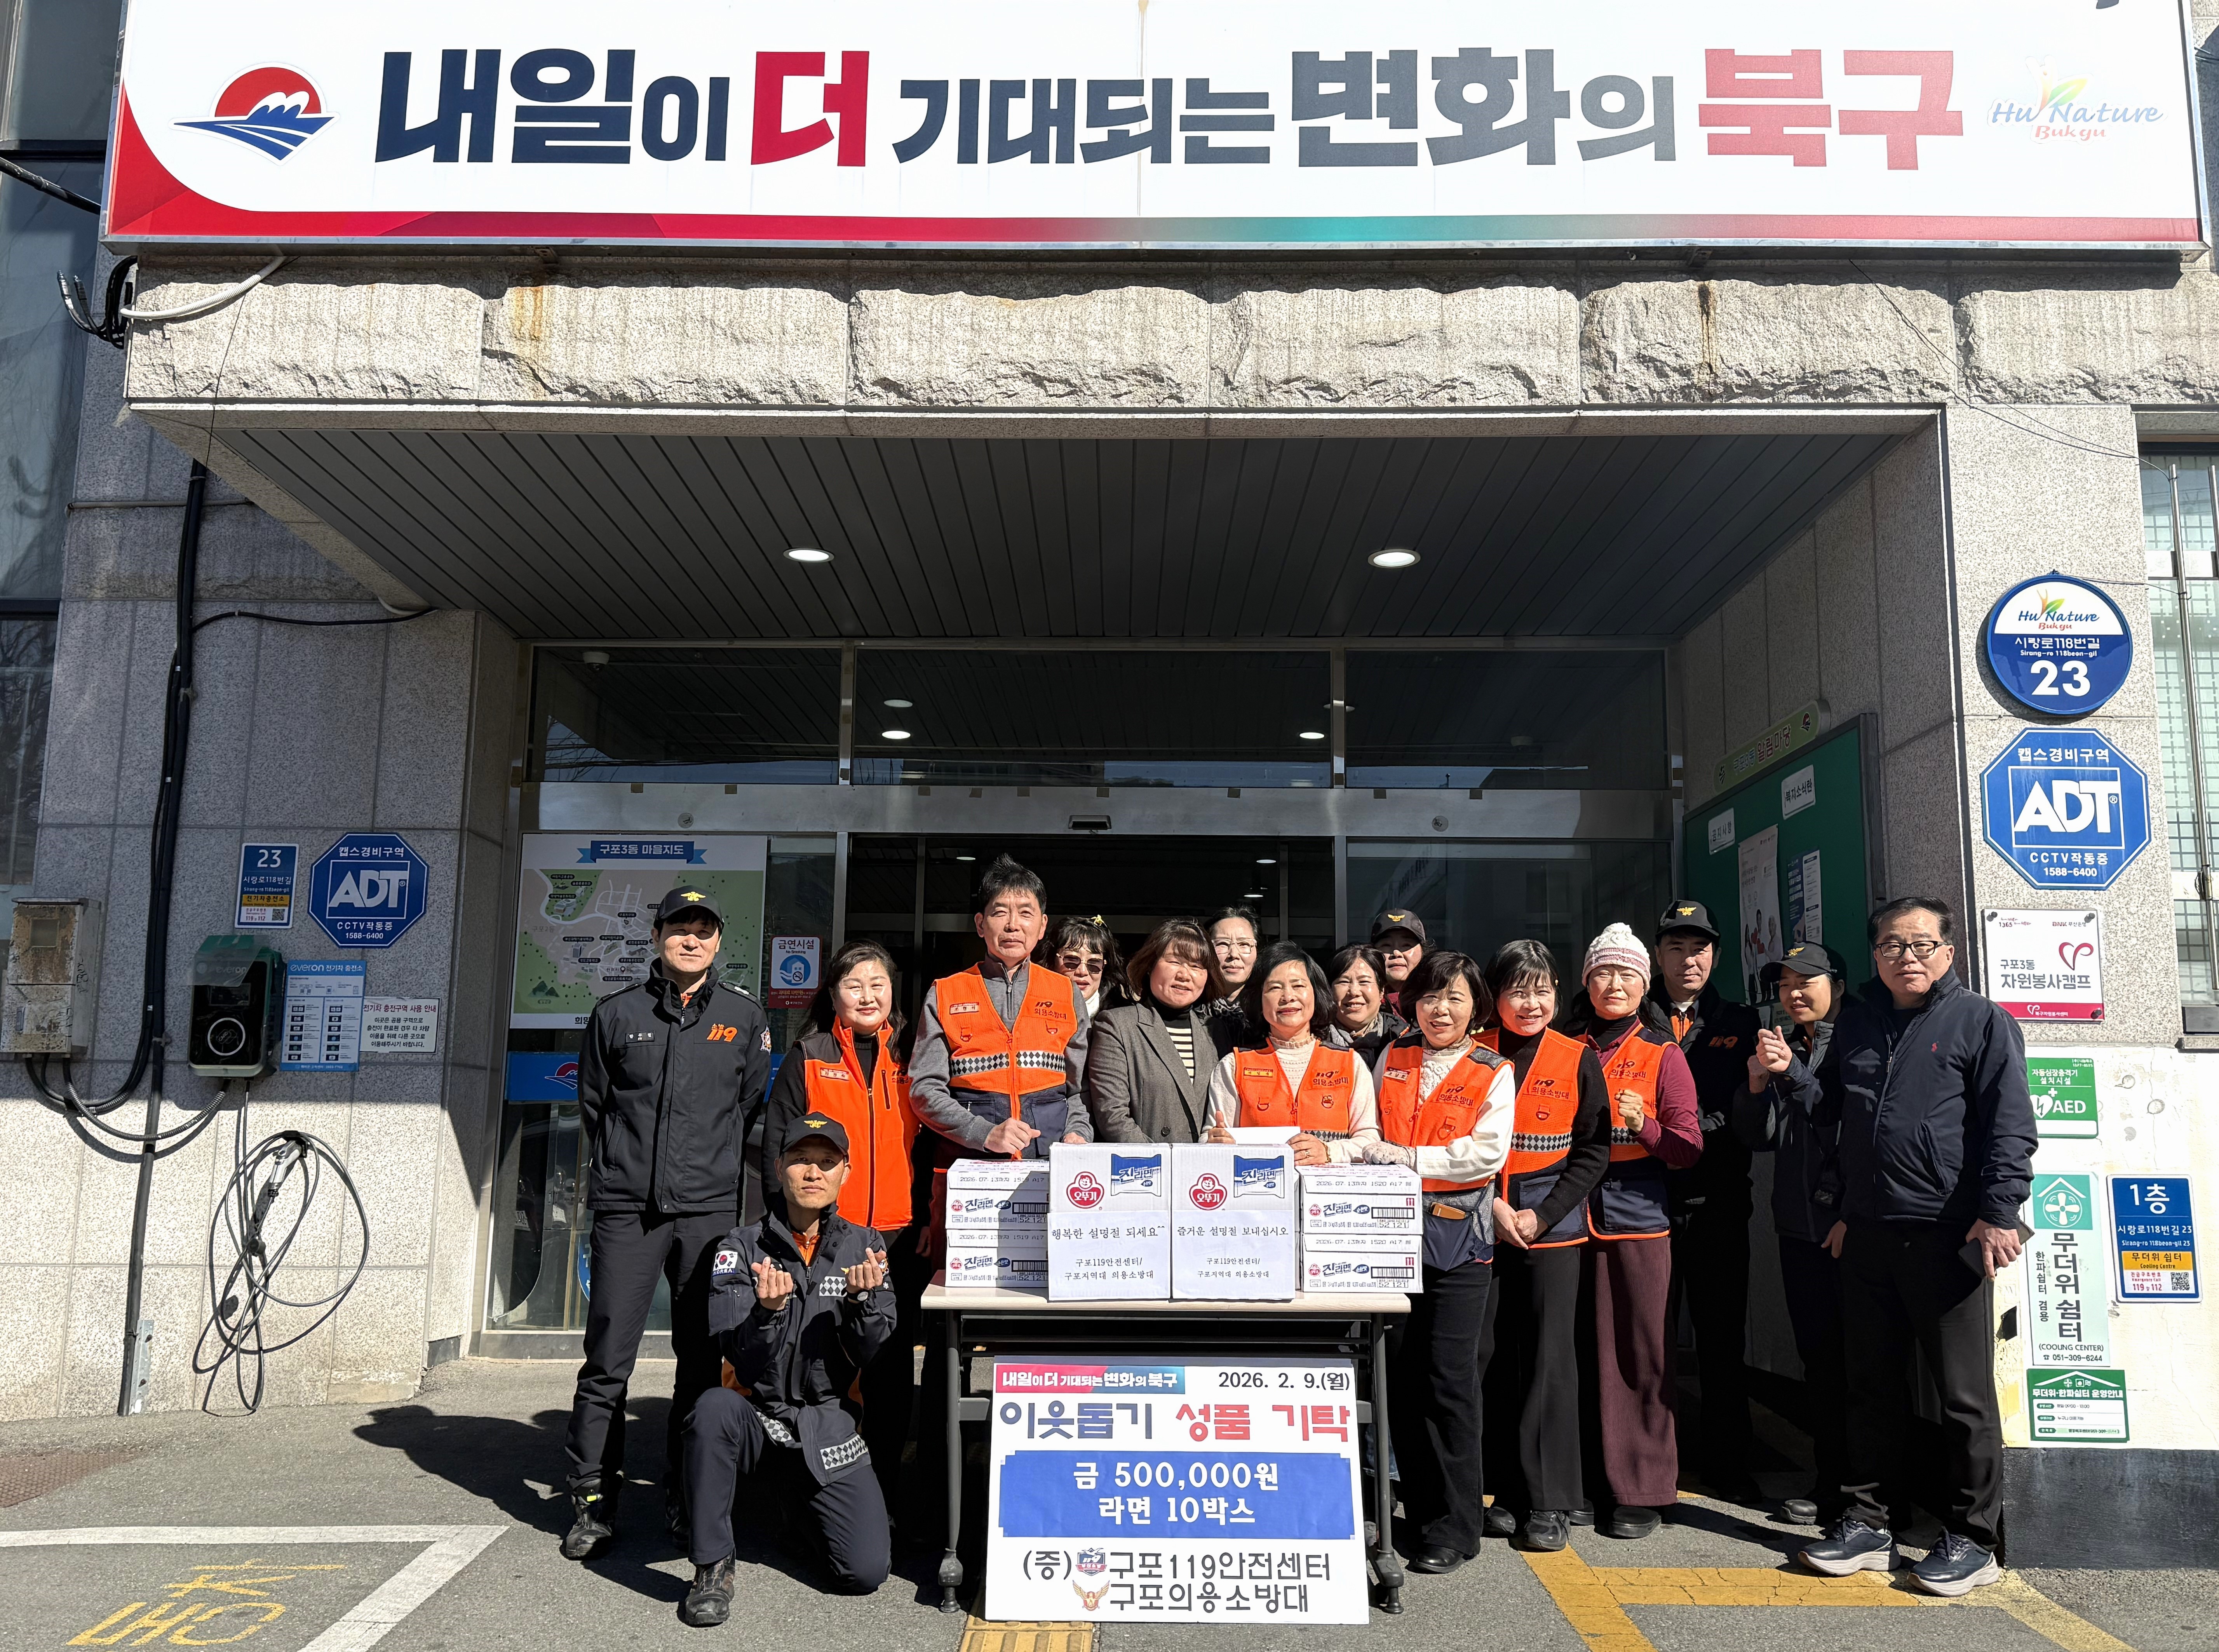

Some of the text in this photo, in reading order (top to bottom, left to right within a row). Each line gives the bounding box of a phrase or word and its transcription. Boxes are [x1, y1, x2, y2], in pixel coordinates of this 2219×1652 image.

[374, 47, 1964, 171] 내일이 더 기대되는 변화의 북구
[1991, 102, 2164, 124] Hu Nature
[2035, 125, 2106, 141] Bukgu
[2018, 611, 2100, 622] Hu Nature
[2038, 622, 2073, 631] Bukgu
[2015, 637, 2100, 649] 시랑로118번길
[2031, 660, 2091, 696] 23
[1757, 725, 1791, 764] 알림마당
[2018, 748, 2110, 763] 캡스경비구역
[1785, 778, 1812, 803] 복지소식란
[2014, 780, 2119, 833] ADT
[1712, 821, 1732, 841] 공지사항
[339, 846, 404, 858] 캡스경비구역
[599, 844, 684, 855] 구포3동 마을지도
[257, 849, 282, 868] 23
[2030, 852, 2108, 865] CCTV작동중
[2043, 867, 2097, 877] 1588-6400
[243, 876, 292, 885] 시랑로118번길
[328, 870, 408, 908] ADT
[336, 921, 393, 931] CCTV작동중
[778, 939, 814, 949] 금연시설
[2000, 959, 2035, 970] 구포3동
[2001, 973, 2091, 990] 자원봉사캠프
[707, 1027, 738, 1043] 119
[1708, 1036, 1738, 1050] 119
[2032, 1069, 2078, 1077] 자동심장충격기
[2040, 1076, 2071, 1085] 설치시설
[1531, 1086, 1569, 1100] 의용소방대
[2052, 1100, 2086, 1114] AED
[1119, 1166, 1154, 1184] 진라면
[1242, 1168, 1277, 1186] 진라면
[1074, 1191, 1097, 1201] 오뚜기
[1197, 1193, 1220, 1203] 오뚜기
[2130, 1183, 2170, 1214] 1층
[1051, 1229, 1083, 1239] 행복한
[1089, 1227, 1121, 1238] 설명절
[1177, 1226, 1289, 1236] 즐거운 설명절 보내십시오
[2118, 1225, 2192, 1236] 시랑로118번길 23
[2131, 1252, 2182, 1263] 무더위 쉼터
[1064, 1271, 1154, 1281] 구포지역대 의용소방대
[2035, 1251, 2049, 1322] 한파쉼터 겸용
[1002, 1372, 1178, 1387] 내일이 더 기대되는 변화의 북구
[1218, 1372, 1350, 1391] 2026. 2. 9.(월)
[2092, 1389, 2123, 1398] 운영안내
[1000, 1400, 1350, 1442] 이웃돕기 성품 기탁
[1073, 1462, 1279, 1492] 금 500,000원
[1099, 1497, 1256, 1526] 라면 10박스
[1023, 1550, 1330, 1581] (증) 119 구포119안전센터
[1109, 1582, 1308, 1614] 구포의용소방대
